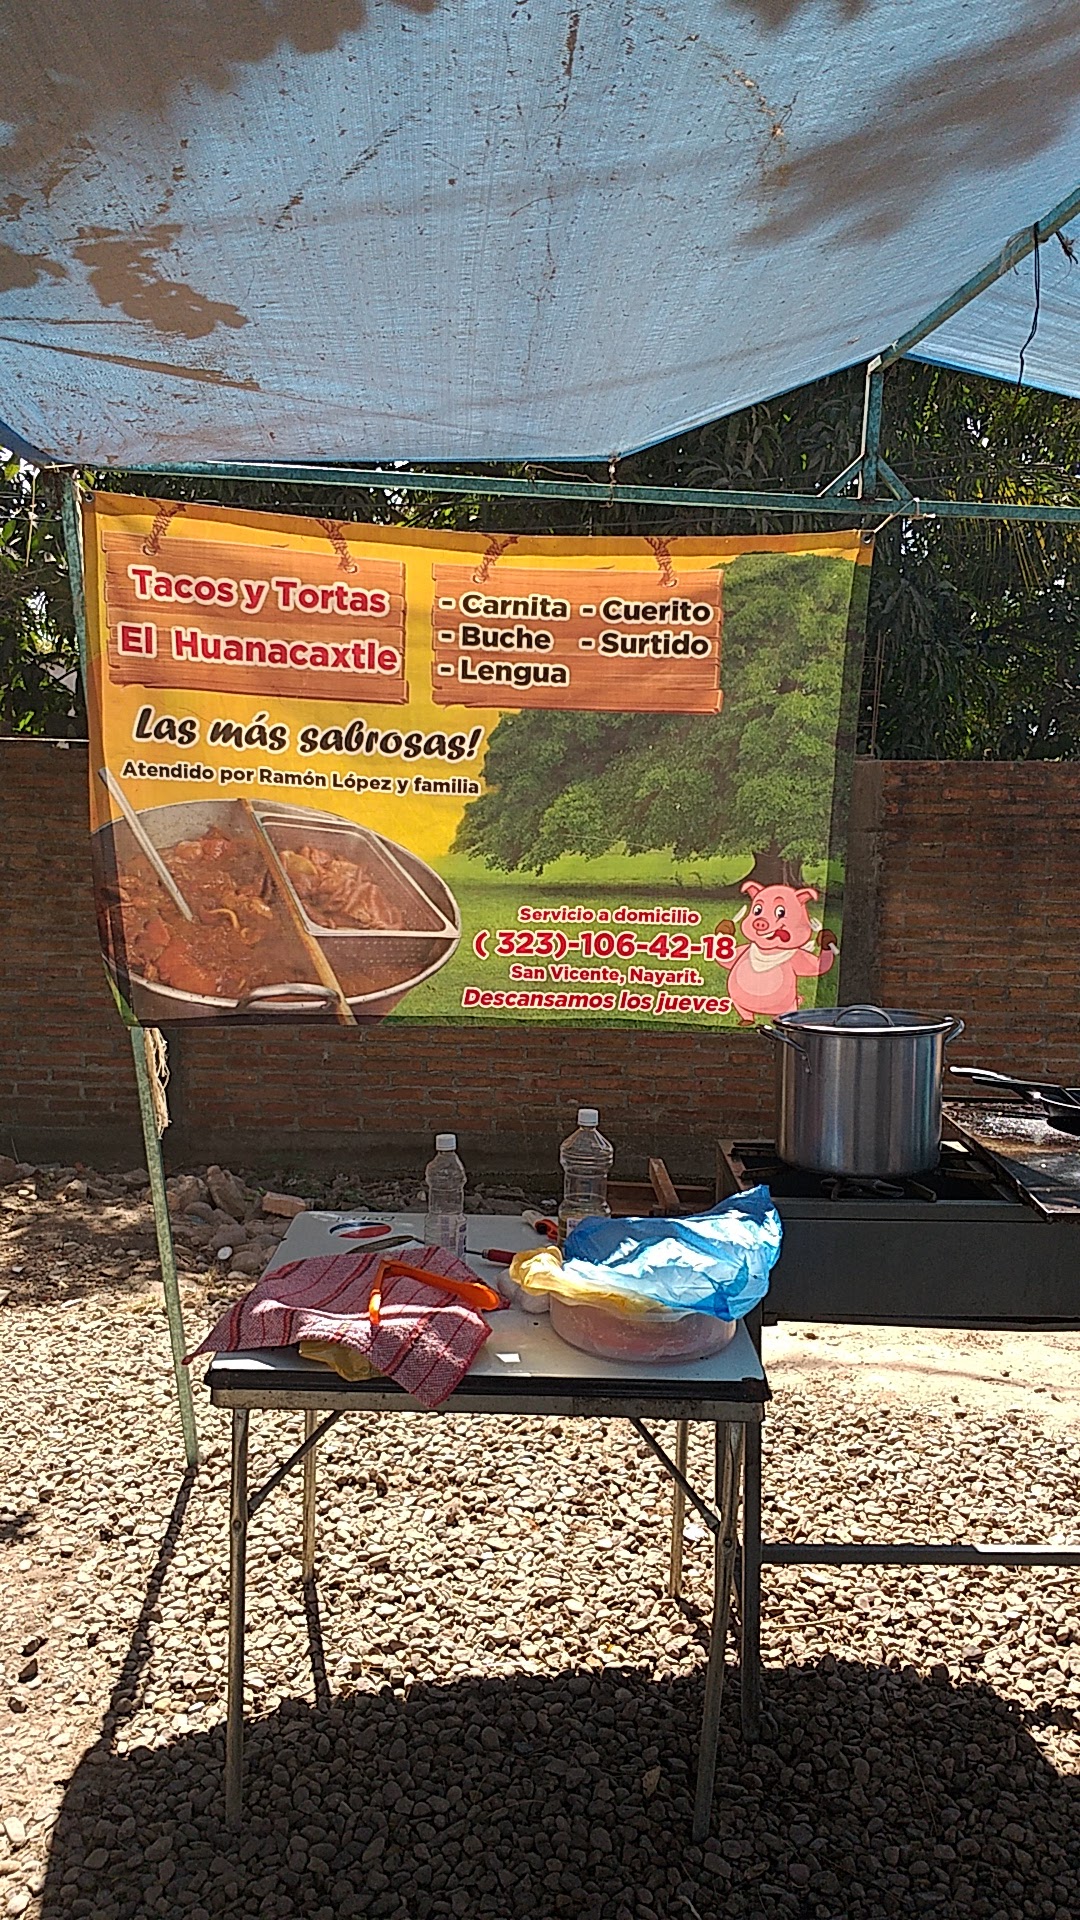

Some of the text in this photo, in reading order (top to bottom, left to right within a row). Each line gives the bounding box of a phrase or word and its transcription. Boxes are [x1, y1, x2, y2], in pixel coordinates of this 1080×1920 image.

[130, 567, 389, 615] Tacos y Tortas
[461, 593, 569, 619] Carnita
[601, 599, 712, 624] Cuerito
[119, 623, 399, 672] El Huanacaxtle
[460, 625, 552, 651] Buche
[600, 631, 710, 657] Surtido
[459, 658, 568, 687] Lengua
[134, 706, 484, 761] Las más sabrosas!
[121, 760, 480, 795] Atendido por Ramón López y familia
[518, 906, 701, 925] Servicio a domicilio
[510, 964, 704, 987] San Vicente, Nayarit.
[462, 987, 732, 1015] Descansamos los jueves
